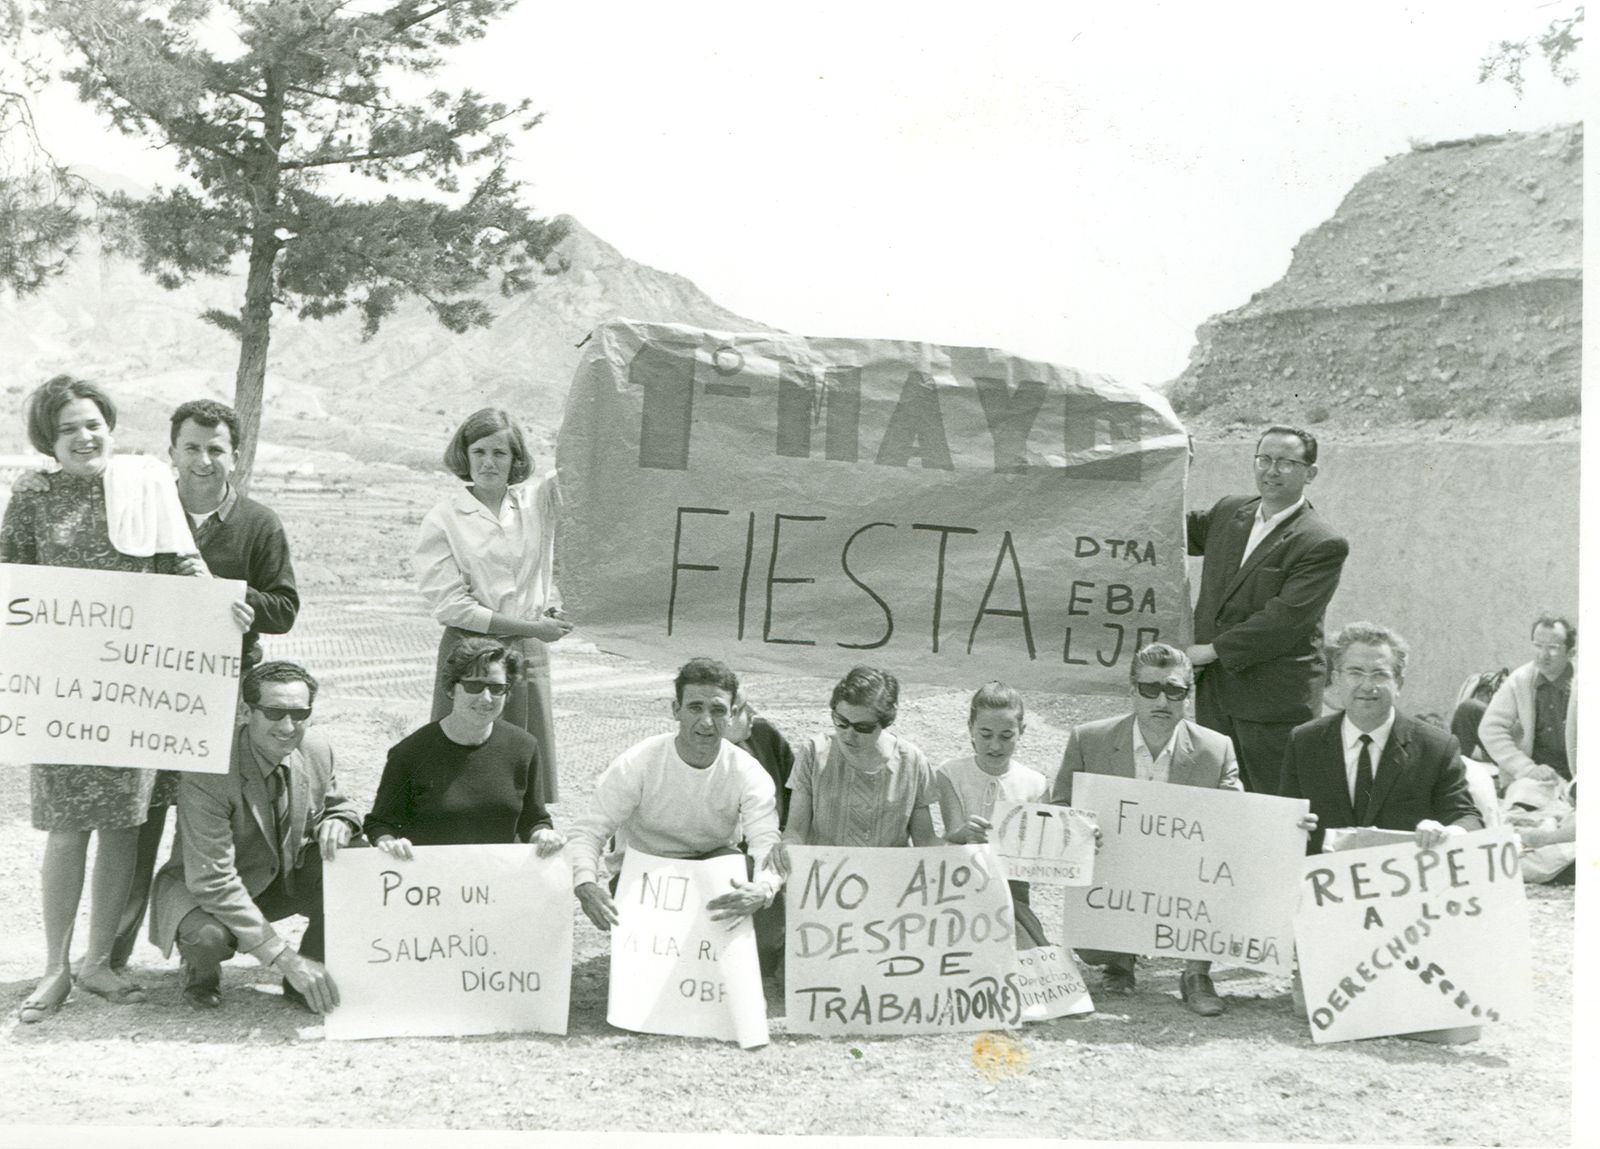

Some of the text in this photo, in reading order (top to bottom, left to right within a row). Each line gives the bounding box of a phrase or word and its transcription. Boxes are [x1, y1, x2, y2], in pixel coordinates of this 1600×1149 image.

[667, 506, 1037, 661] FIESTA
[6, 597, 135, 630] SALARIO
[100, 640, 241, 679] SUFICIENTE
[56, 677, 83, 699] LA
[91, 680, 207, 716] JORNADA
[0, 714, 209, 758] DE OCHO HORAS
[1117, 799, 1205, 842] FUERA
[380, 870, 441, 906] POR
[799, 856, 869, 910] NO
[1198, 856, 1235, 887] LA
[1304, 841, 1520, 907] RESPETO
[640, 871, 690, 912] NO
[1086, 886, 1212, 923] CULTURA
[794, 904, 1015, 960] DESPIDOS
[1363, 896, 1482, 931] A LOS
[653, 935, 681, 958] LA
[876, 951, 974, 978] DE
[1037, 948, 1057, 962] de
[1311, 918, 1432, 1031] DERECHOS
[794, 972, 1023, 1026] TRABAJADORES
[1021, 981, 1089, 1008] UMANOS
